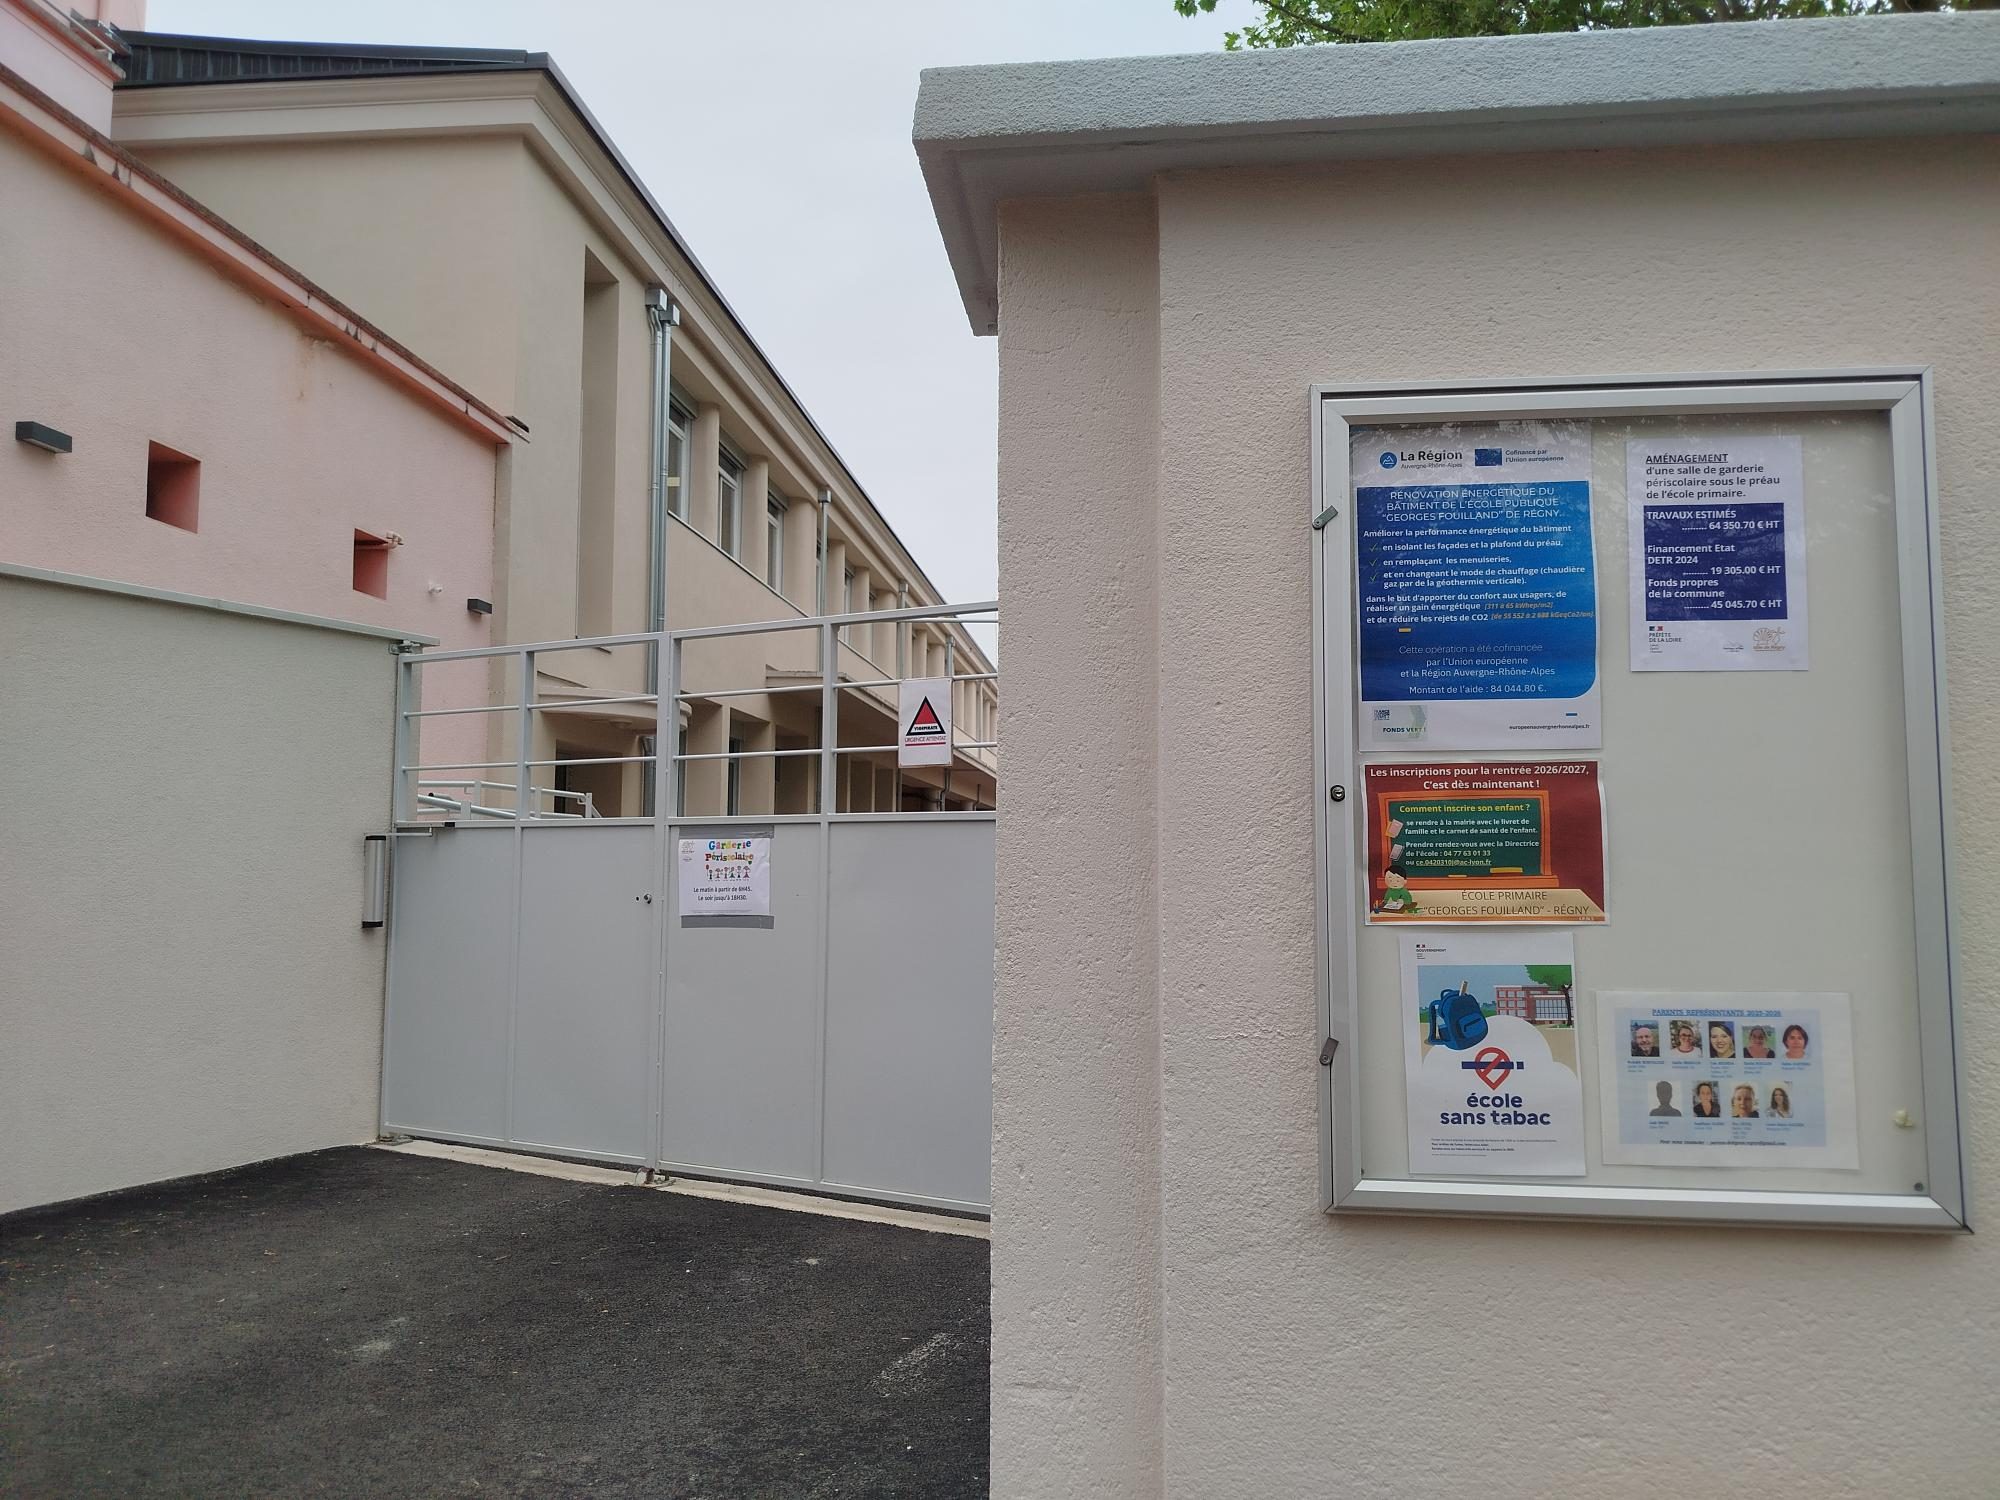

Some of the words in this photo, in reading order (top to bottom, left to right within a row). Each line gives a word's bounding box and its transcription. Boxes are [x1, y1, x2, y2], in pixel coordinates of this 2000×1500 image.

[1400, 451, 1415, 462] La
[1418, 450, 1463, 463] Région
[1528, 456, 1564, 464] européenne
[1646, 453, 1729, 464] AMÉNAGEMENT
[1646, 466, 1674, 475] d'une
[1677, 465, 1701, 475] salle
[1703, 465, 1717, 474] de
[1719, 464, 1764, 476] garderie
[1646, 477, 1707, 489] périscolaire
[1709, 478, 1734, 486] sous
[1736, 476, 1747, 486] le
[1749, 476, 1781, 487] préau
[1390, 490, 1459, 499] RÉNOVATION
[1461, 487, 1536, 498] ÉNERGÉTIQUE
[1538, 488, 1555, 496] DU
[1646, 490, 1659, 499] de
[1697, 488, 1746, 500] primaire.
[1387, 501, 1439, 511] BÂTIMENT
[1442, 501, 1457, 510] DE
[1505, 498, 1560, 508] PUBLIQUE
[1506, 510, 1521, 519] DE
[1646, 511, 1694, 520] TRAVAUX
[1695, 508, 1737, 519] ESTIMÉS
[1709, 521, 1721, 530] 64
[1723, 521, 1755, 530] 350.70
[1757, 520, 1764, 529] €
[1765, 520, 1780, 529] HT
[1363, 529, 1404, 538] Améliorer
[1414, 528, 1467, 538] performance
[1469, 526, 1519, 535] énergétique
[1520, 525, 1531, 533] du
[1647, 544, 1713, 553] Financement
[1714, 543, 1735, 552] Etat
[1396, 557, 1442, 567] remplaçant
[1647, 556, 1674, 565] DETR
[1675, 556, 1698, 564] 2024
[1405, 570, 1450, 579] changeant
[1460, 568, 1484, 576] mode
[1497, 567, 1539, 576] chauffage
[1540, 565, 1586, 575] (chaudière
[1711, 566, 1722, 575] 19
[1724, 566, 1757, 575] 305.00
[1758, 566, 1765, 574] €
[1767, 566, 1781, 574] HT
[1383, 581, 1398, 589] gaz
[1400, 580, 1413, 588] par
[1427, 579, 1435, 587] la
[1436, 578, 1485, 588] géothermie
[1648, 578, 1678, 587] Fonds
[1679, 578, 1719, 589] propres
[1648, 589, 1661, 598] de
[1662, 589, 1672, 598] la
[1674, 589, 1725, 598] commune
[1711, 600, 1723, 609] 45
[1725, 600, 1758, 609] 045.70
[1760, 599, 1766, 608] €
[1768, 599, 1782, 608] HT
[1426, 659, 1440, 668] par
[1475, 656, 1529, 666] européenne
[1400, 670, 1409, 678] et
[1411, 669, 1419, 677] la
[1421, 668, 1451, 679] Région
[1453, 667, 1556, 678] Auvergne-Rhône-Alpes
[1409, 686, 1445, 694] Montant
[1370, 768, 1388, 777] Les
[1389, 767, 1451, 779] inscriptions
[1453, 768, 1478, 778] pour
[1480, 766, 1490, 775] la
[1492, 765, 1532, 775] rentrée
[1451, 779, 1470, 789] dès
[1472, 779, 1535, 789] maintenant
[1399, 805, 1442, 813] Comment
[1443, 804, 1476, 812] inscrire
[1494, 804, 1525, 812] enfant
[708, 840, 752, 850] Garderie
[1461, 890, 1495, 900] ÉCOLE
[1498, 891, 1548, 900] PRIMAIRE
[1553, 904, 1590, 915] RÉGNY
[1652, 1009, 1684, 1017] PARENTS
[1466, 1092, 1523, 1108] école
[1440, 1111, 1486, 1125] sans
[1490, 1110, 1551, 1125] tabac
